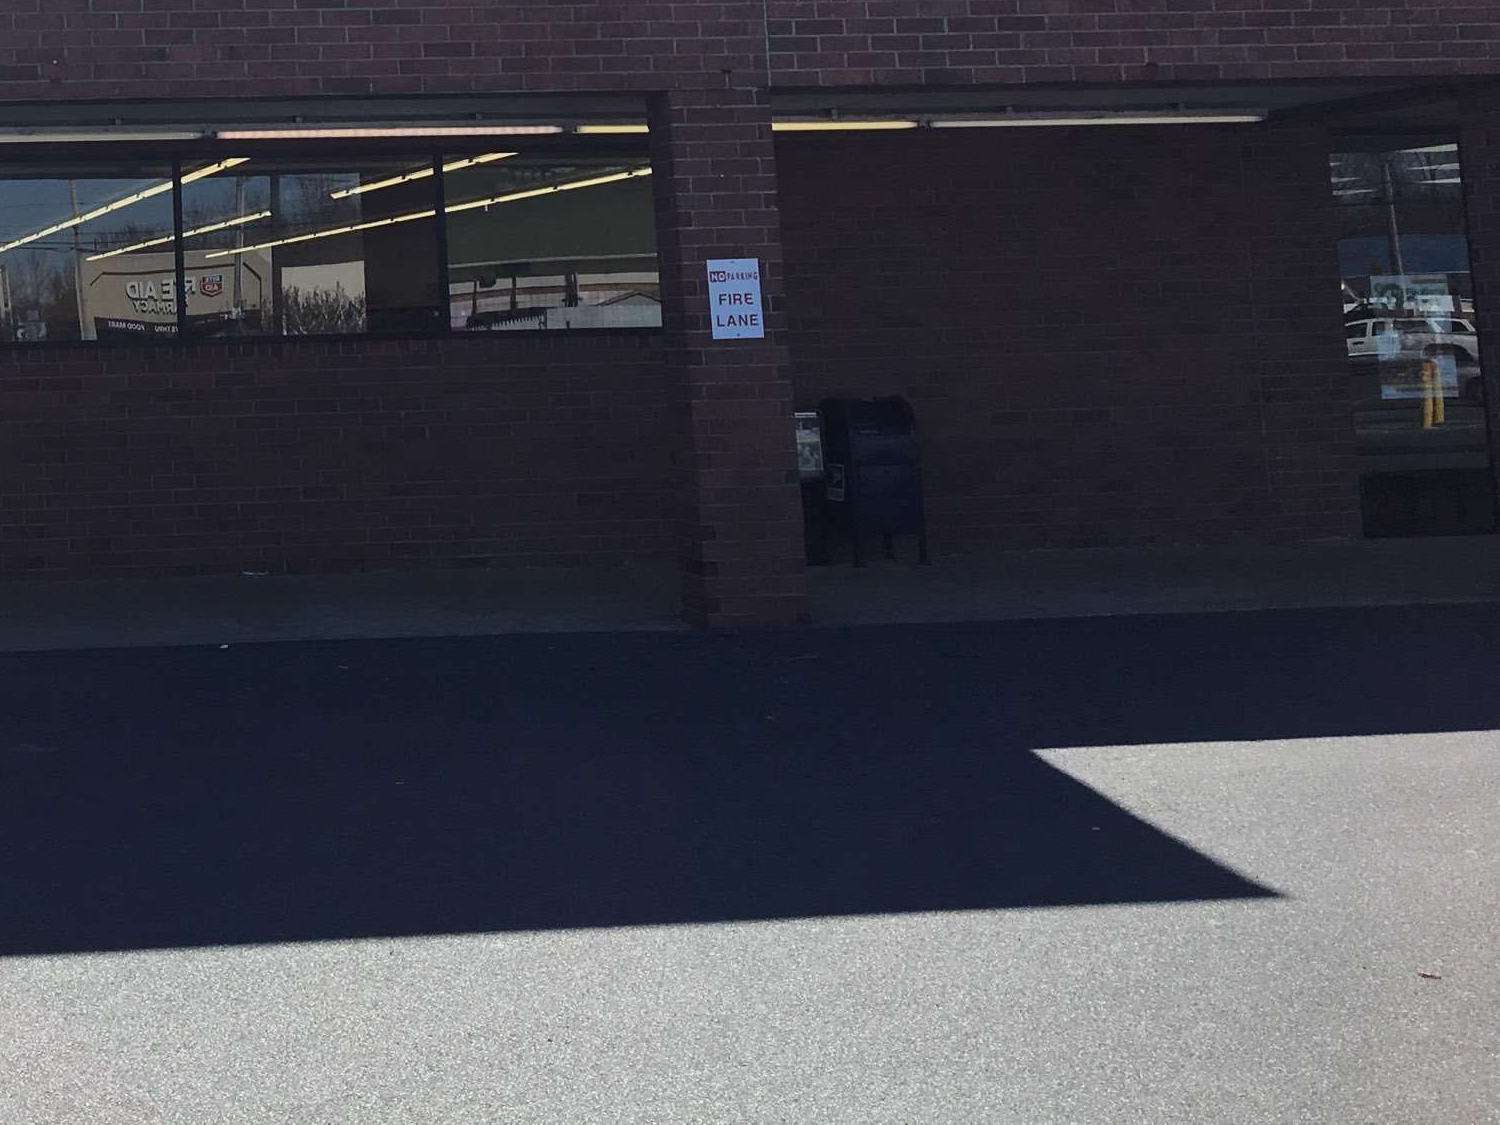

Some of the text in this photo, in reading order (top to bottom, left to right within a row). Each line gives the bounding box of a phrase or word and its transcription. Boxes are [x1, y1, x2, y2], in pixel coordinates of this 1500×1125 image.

[710, 271, 758, 283] NO PARKING
[719, 293, 754, 306] FIRE
[717, 314, 759, 327] LANE
